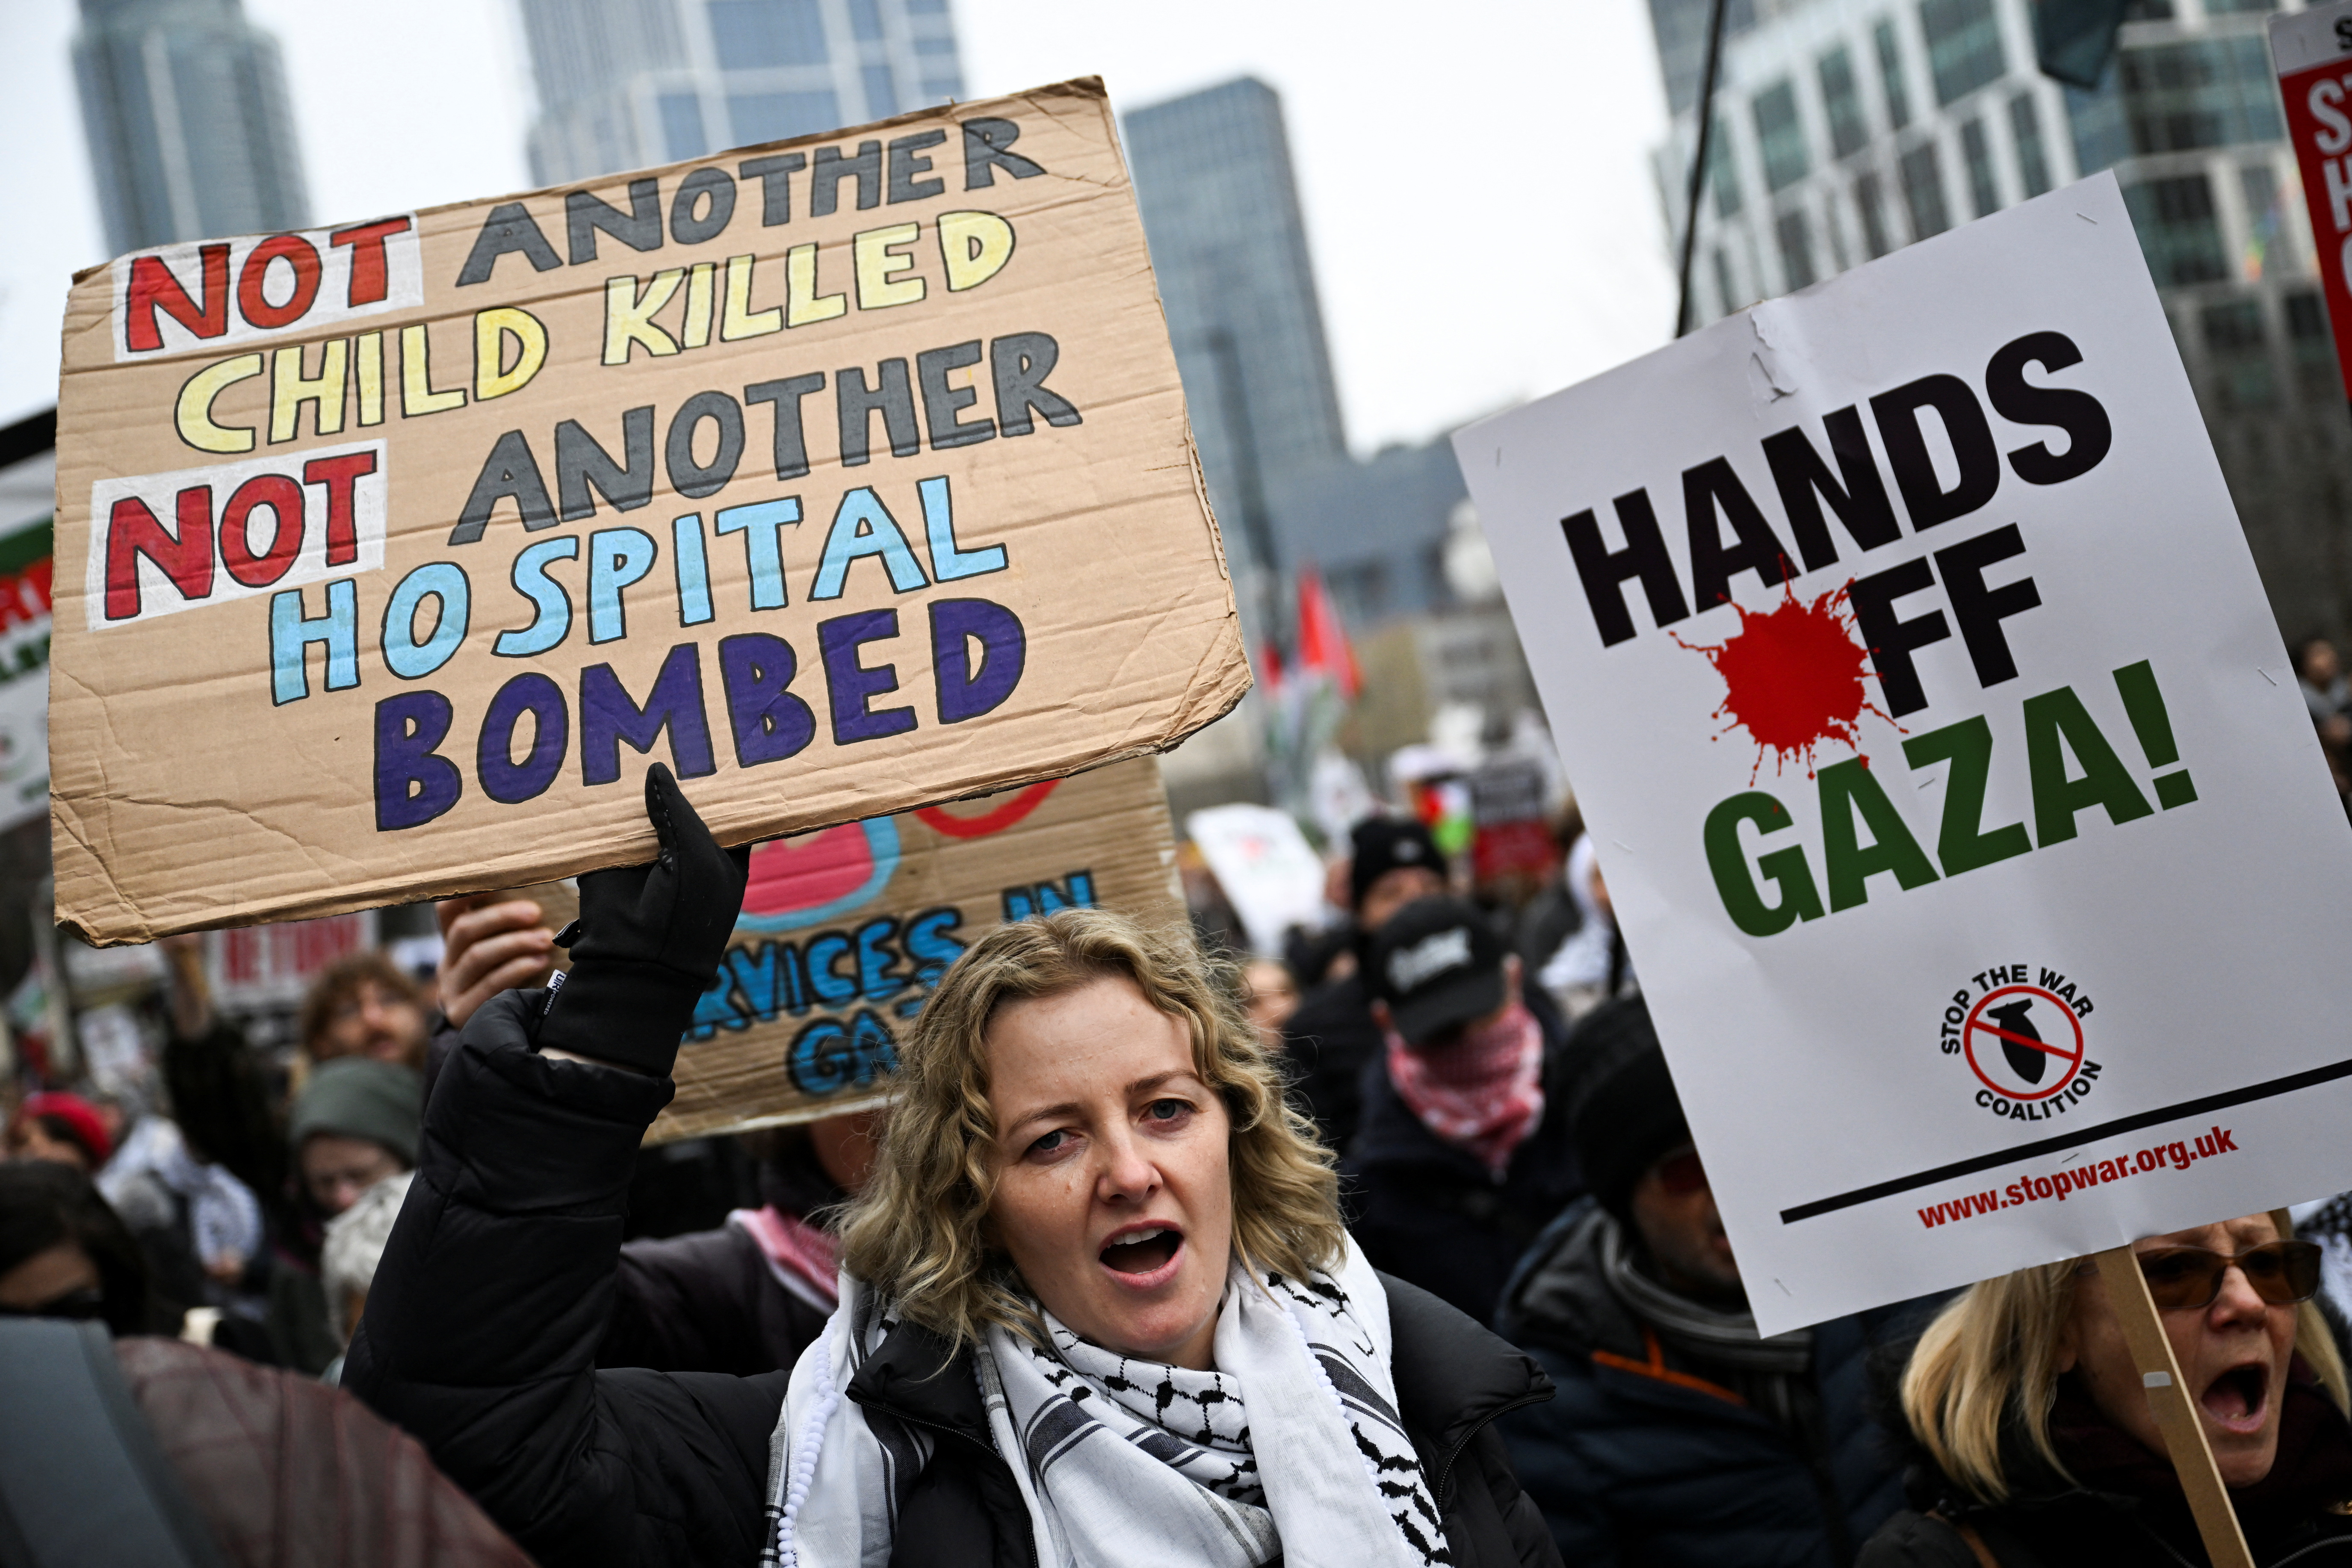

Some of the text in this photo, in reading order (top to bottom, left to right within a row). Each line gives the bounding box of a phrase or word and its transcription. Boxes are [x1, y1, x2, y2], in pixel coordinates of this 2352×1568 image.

[125, 116, 1047, 352] NOT ANOTHER
[174, 210, 1016, 454] CHILD KILLED
[104, 449, 378, 621] NOT
[447, 331, 1083, 546] ANOTHER
[269, 475, 1008, 706] HOSPITAL
[1560, 330, 2113, 648] HANDS
[373, 597, 1026, 832] BOMBED
[1703, 659, 2199, 938] GAZA!
[682, 907, 965, 1043] RVICES
[788, 997, 926, 1096] GA
[1941, 963, 2095, 1055] STOP THE WAR
[1974, 1059, 2103, 1121] COALITION
[1917, 1125, 2239, 1228] www.stopwar.org.uk
